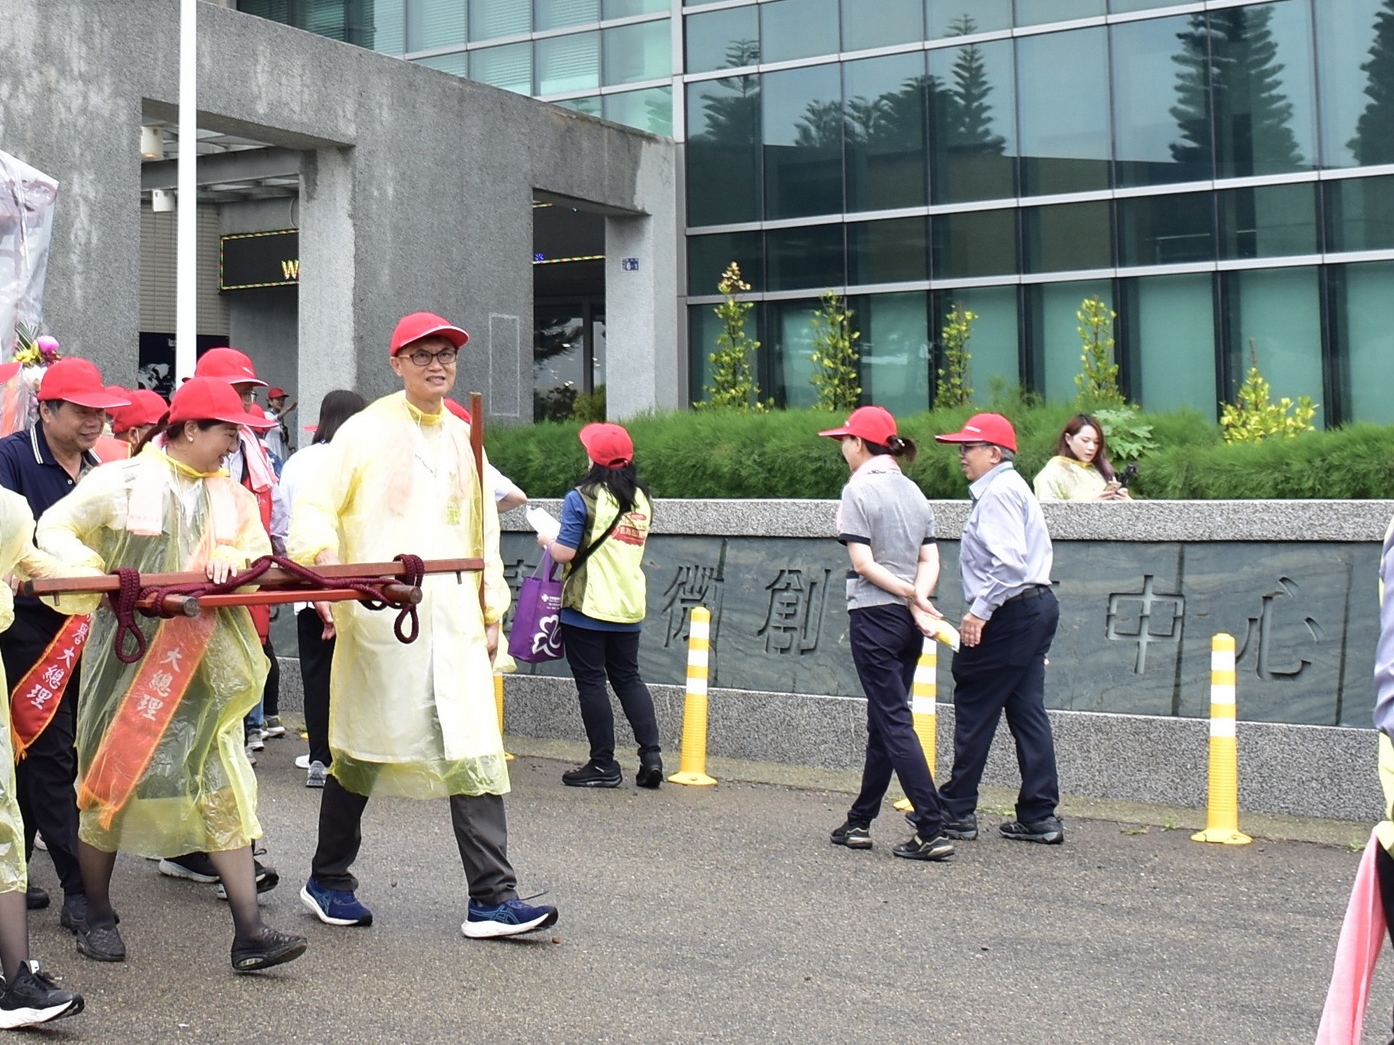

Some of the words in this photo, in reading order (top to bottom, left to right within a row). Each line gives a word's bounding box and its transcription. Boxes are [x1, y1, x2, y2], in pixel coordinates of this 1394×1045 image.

[26, 612, 93, 710] 譽大總理
[137, 647, 183, 722] 大總理
